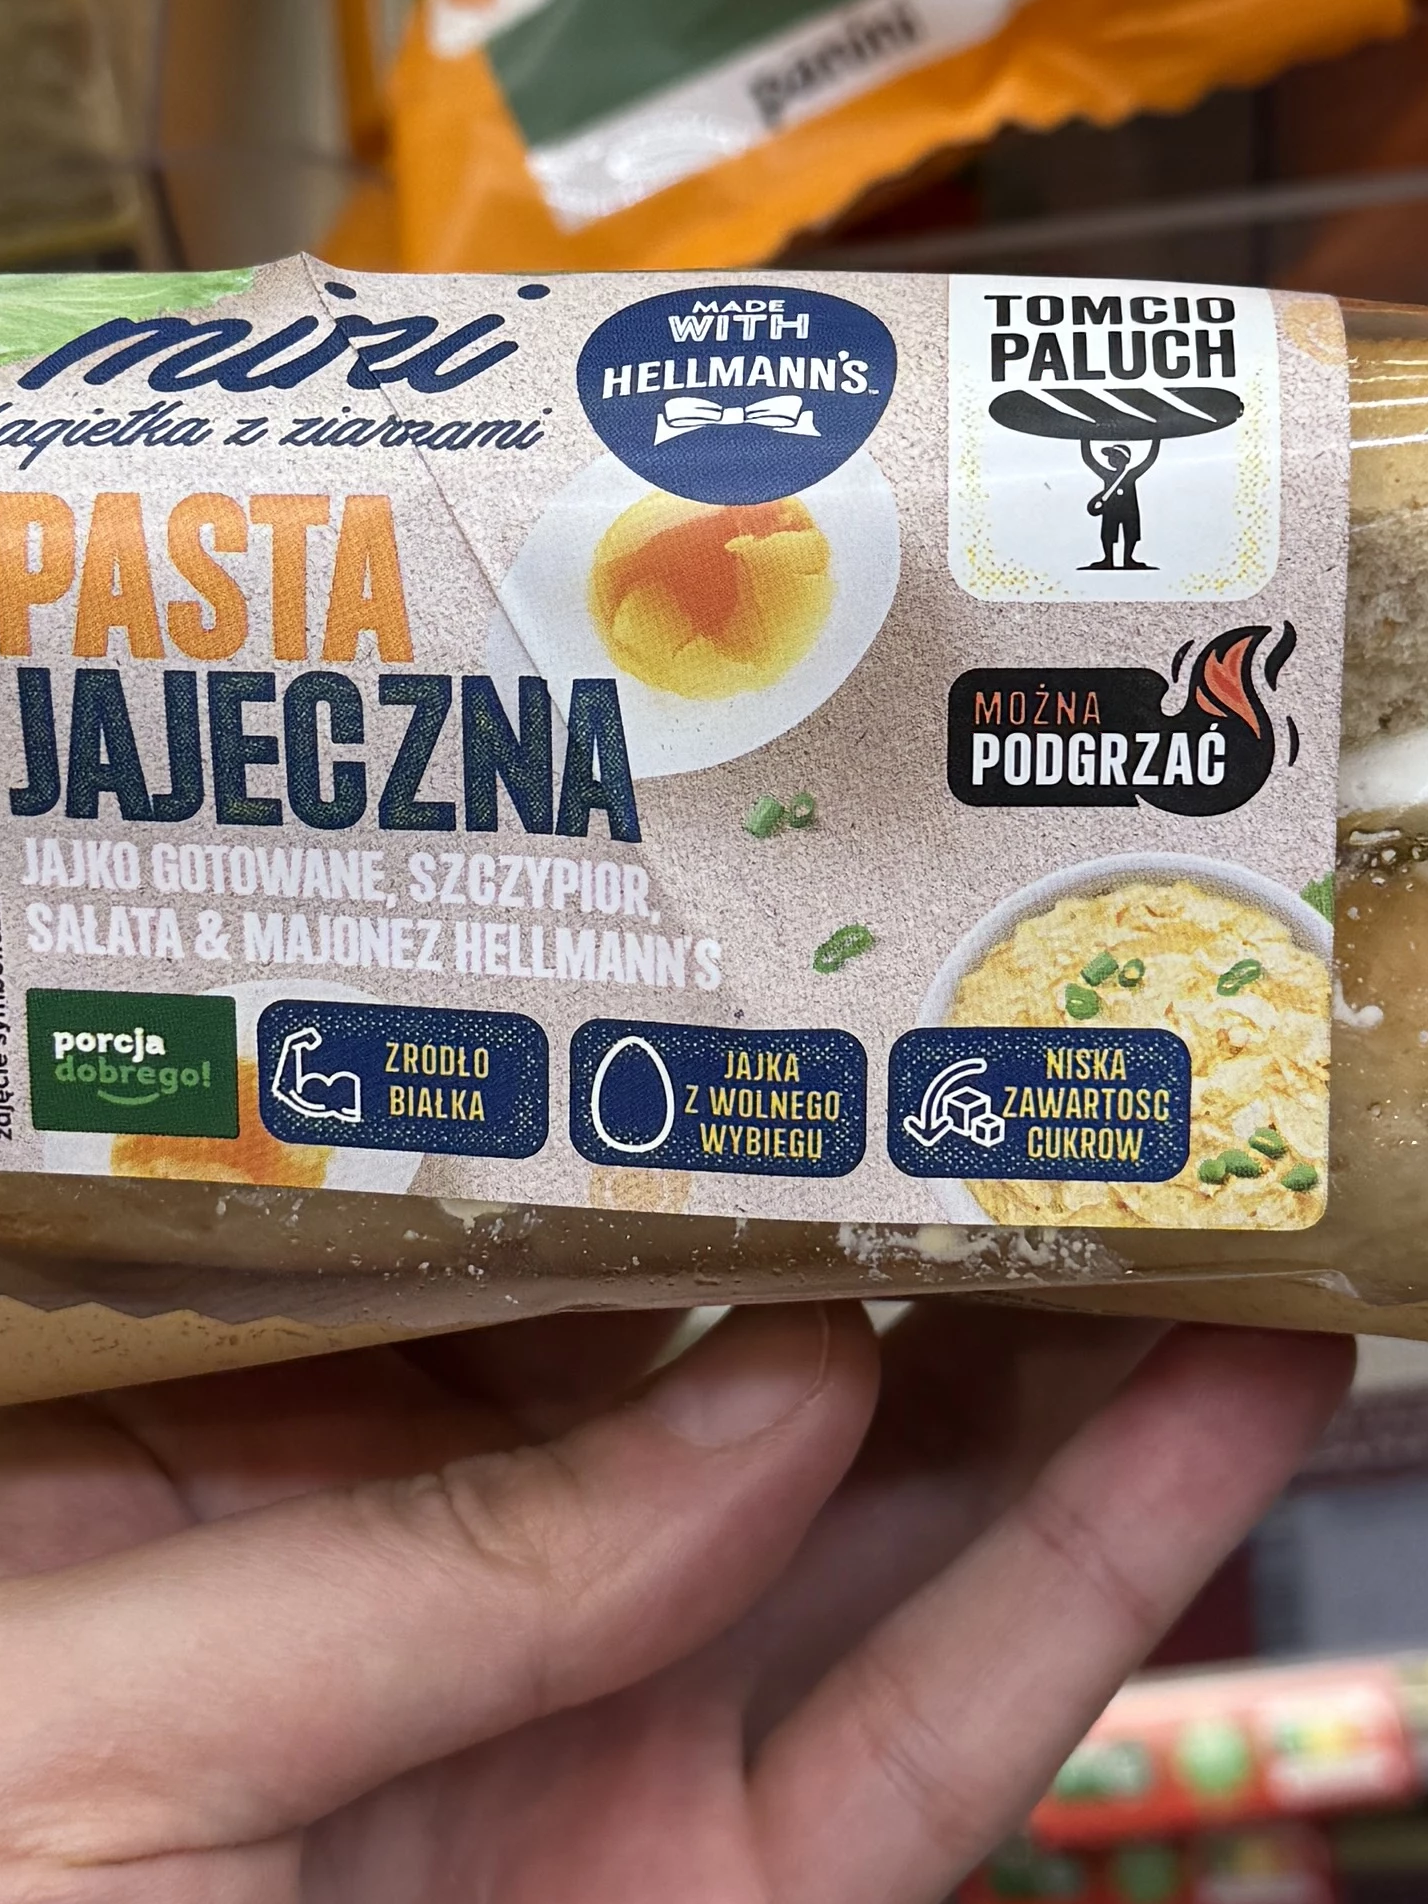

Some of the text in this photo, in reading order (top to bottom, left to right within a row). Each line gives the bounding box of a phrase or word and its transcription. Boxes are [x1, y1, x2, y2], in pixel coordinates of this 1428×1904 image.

[691, 298, 786, 316] MADE
[984, 294, 1237, 328] TOMCIO
[18, 282, 551, 394] mini
[668, 312, 810, 345] WITH
[601, 349, 871, 400] HELLMANN'S
[989, 328, 1237, 383] PALUCH
[223, 415, 270, 448] z
[278, 405, 553, 452] ziarnami
[973, 684, 1102, 728] MOŻNA
[10, 667, 642, 844] JAJECZNA
[972, 721, 1227, 788] PODGRZAĆ
[20, 837, 662, 925] JAJKO GOTOWANE, SZCZYPIOR,
[24, 902, 723, 992] SAŁATA & MAJONEZ HELLMANN'S
[53, 1026, 167, 1064] porcja
[1045, 1047, 1127, 1081] NISKA
[54, 1055, 212, 1095] dobrego!
[723, 1049, 801, 1083] JAJKA
[389, 1084, 486, 1122] BIAŁKA
[684, 1083, 841, 1122] Z WOLNEGO
[699, 1122, 822, 1160] WYBIEGU
